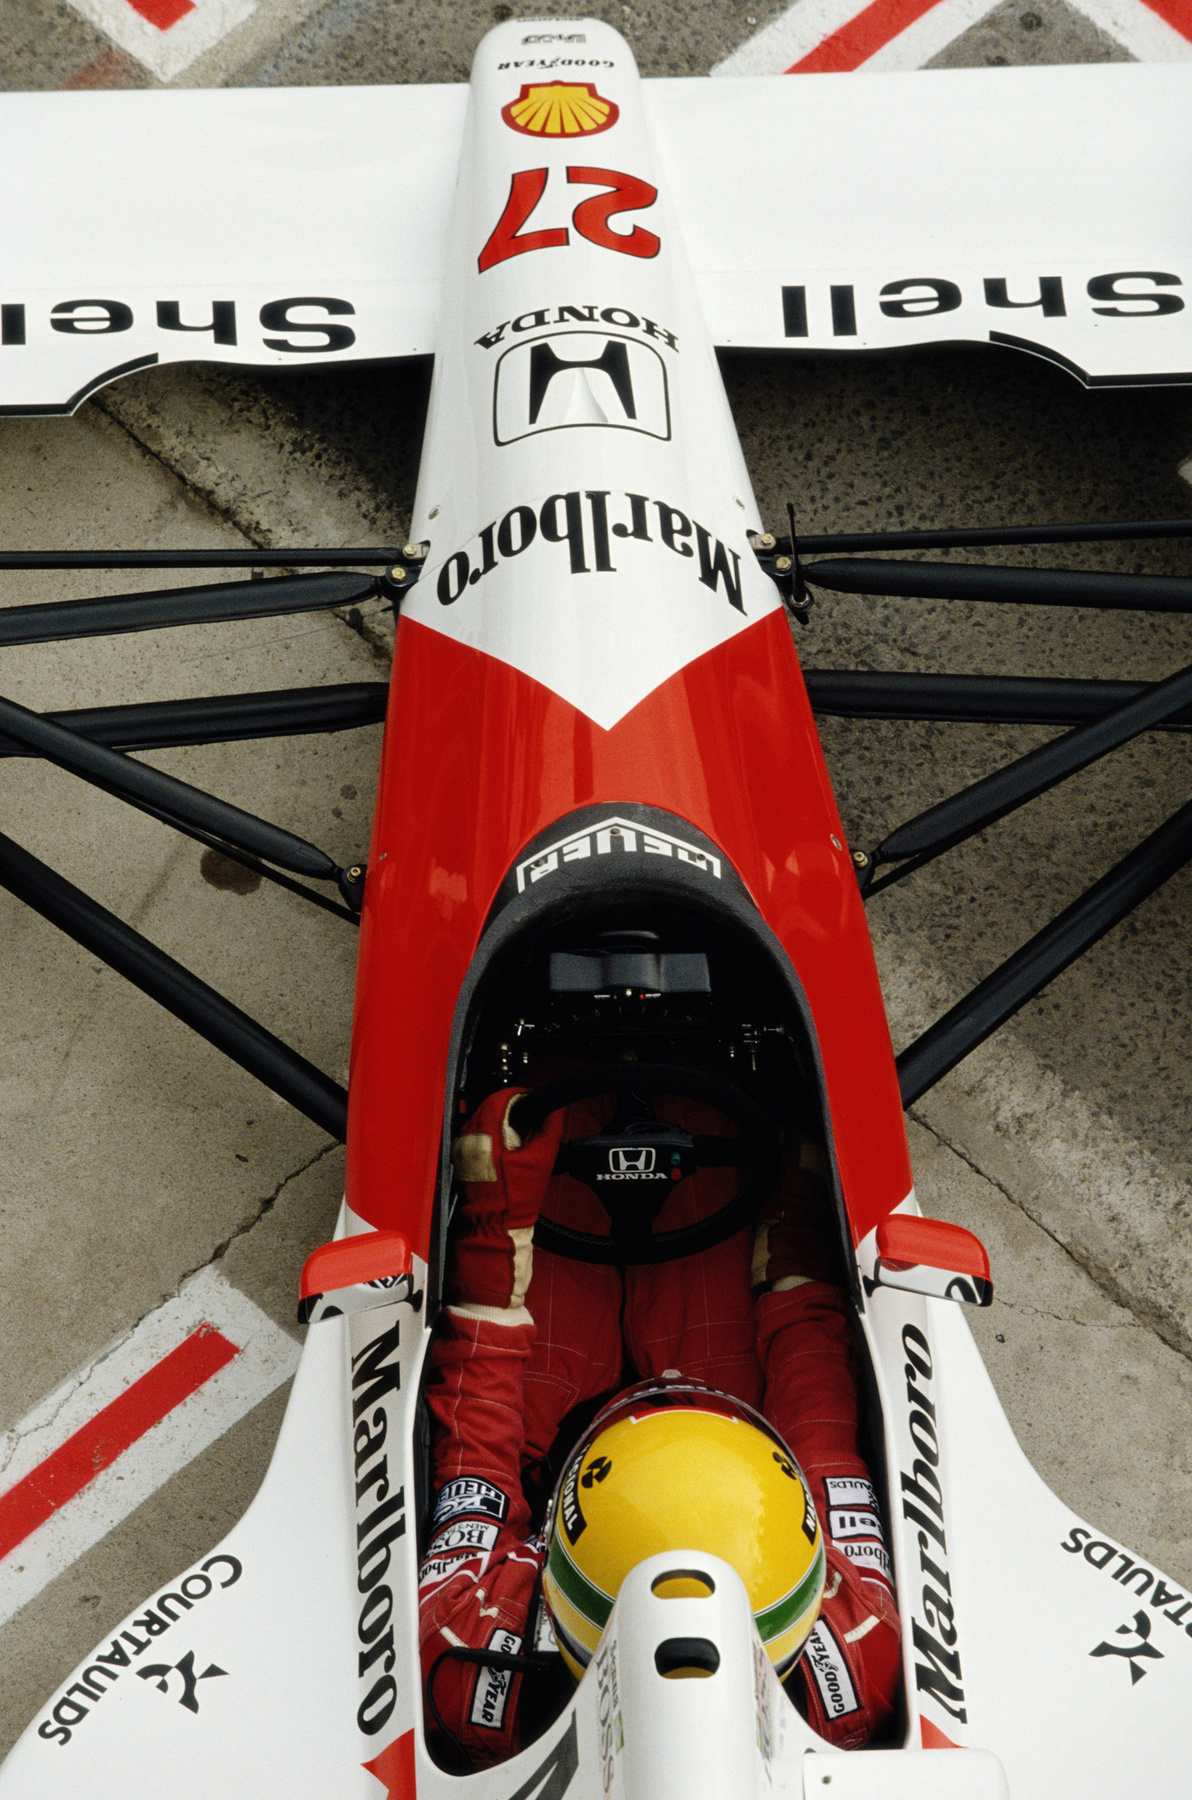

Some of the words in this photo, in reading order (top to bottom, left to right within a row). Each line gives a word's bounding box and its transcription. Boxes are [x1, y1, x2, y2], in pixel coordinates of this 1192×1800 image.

[497, 58, 615, 70] GOODYEAR
[477, 166, 662, 275] 27
[1, 297, 356, 353] Shel
[474, 306, 678, 352] HONDA
[782, 272, 1185, 338] Shell
[437, 490, 748, 616] Marlboro
[596, 1173, 668, 1181] HONDA
[352, 1319, 406, 1736] Marlboro
[440, 1481, 495, 1501] HEUE
[900, 1323, 967, 1724] Marlboro
[1060, 1527, 1192, 1638] TAULDS
[38, 1554, 243, 1746] COURTAULDS
[482, 1635, 515, 1723] GOYEAR
